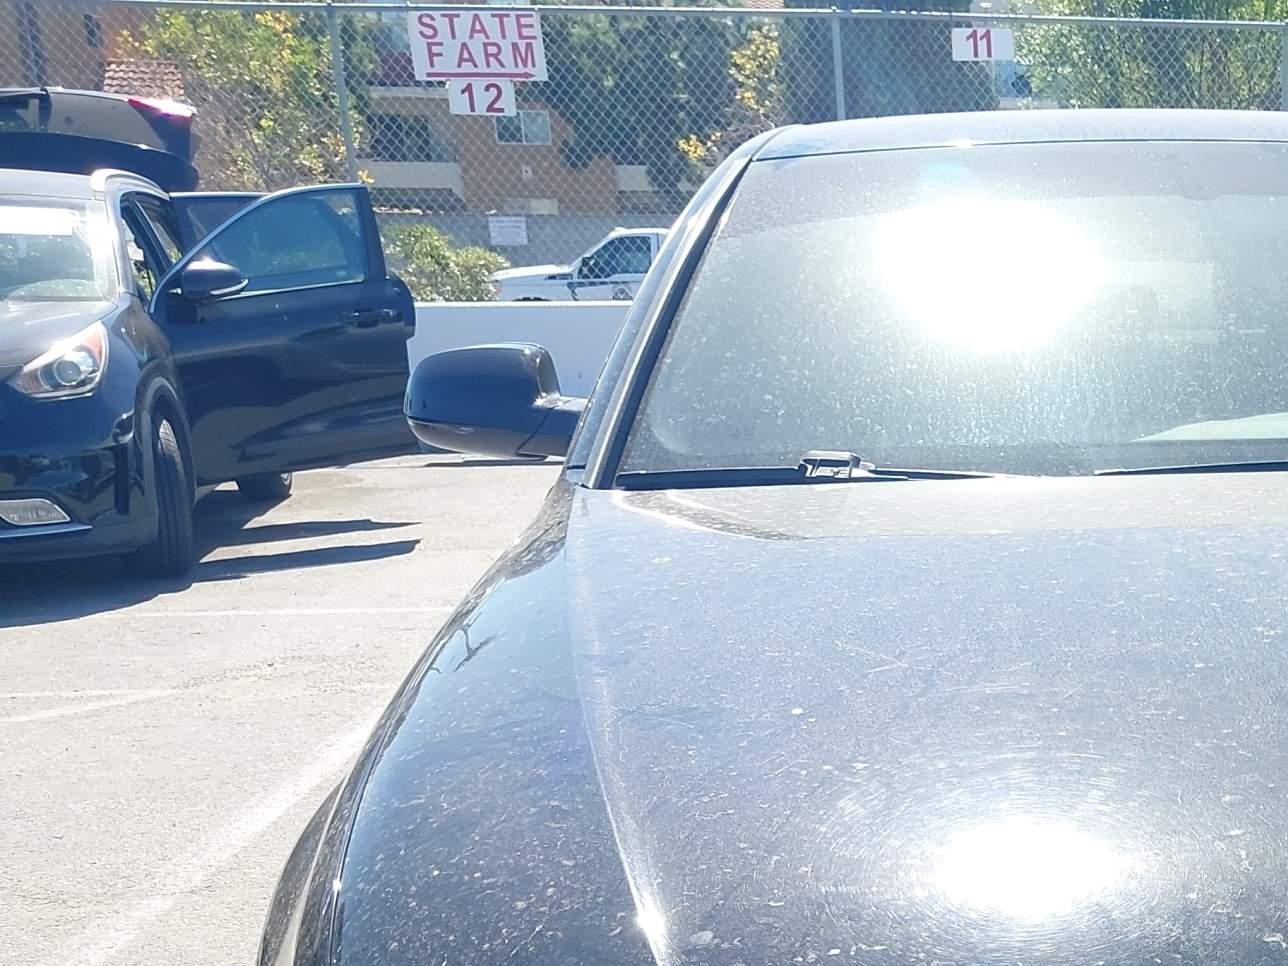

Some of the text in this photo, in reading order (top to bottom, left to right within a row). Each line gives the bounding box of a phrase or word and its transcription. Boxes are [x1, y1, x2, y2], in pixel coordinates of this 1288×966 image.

[417, 13, 537, 40] STATE
[426, 42, 536, 68] FARM
[966, 29, 992, 58] 11
[460, 83, 505, 113] 12
